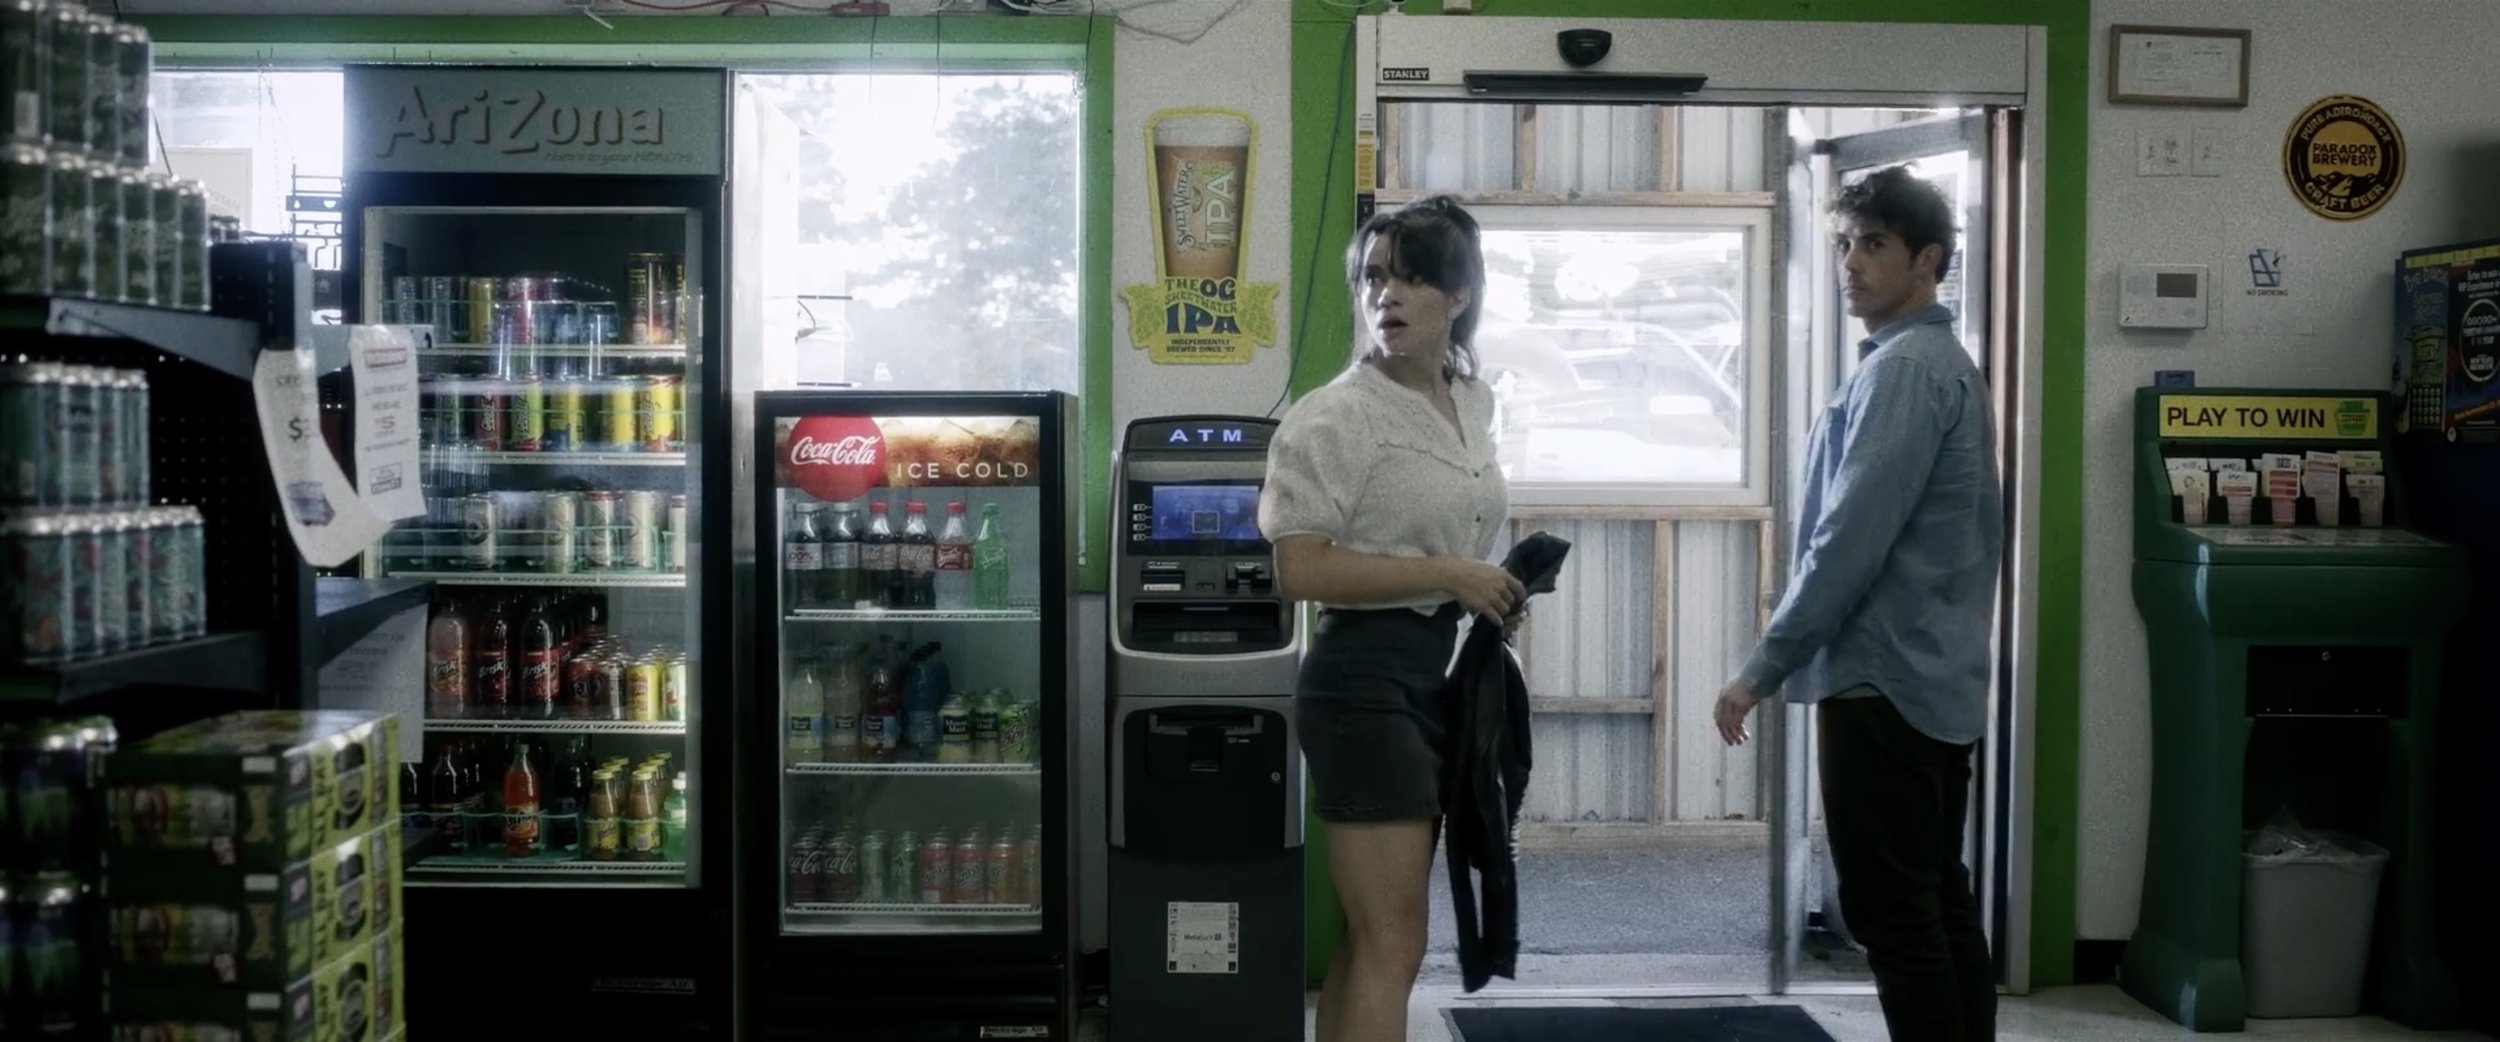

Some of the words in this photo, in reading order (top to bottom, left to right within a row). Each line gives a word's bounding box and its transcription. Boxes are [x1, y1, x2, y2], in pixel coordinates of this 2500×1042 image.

[1384, 69, 1429, 80] STANLEY
[376, 85, 663, 158] AriZona
[2301, 114, 2326, 141] PURE
[2326, 106, 2392, 143] ADIRONDACK
[2312, 143, 2377, 155] PARADOX
[2312, 153, 2377, 166] BREWERY
[2305, 182, 2348, 209] CRAFT
[2350, 184, 2385, 209] BEER
[1206, 169, 1235, 246] IPA
[1164, 278, 1199, 291] THE
[1200, 278, 1236, 301] OG
[1166, 303, 1241, 334] IPA
[2167, 407, 2228, 427] PLAY
[2236, 407, 2268, 427] TO
[2277, 408, 2325, 428] WIN
[1169, 428, 1243, 443] ATM
[790, 435, 881, 466] Coca-Cola
[896, 462, 940, 478] ICE
[956, 462, 1028, 479] COLD
